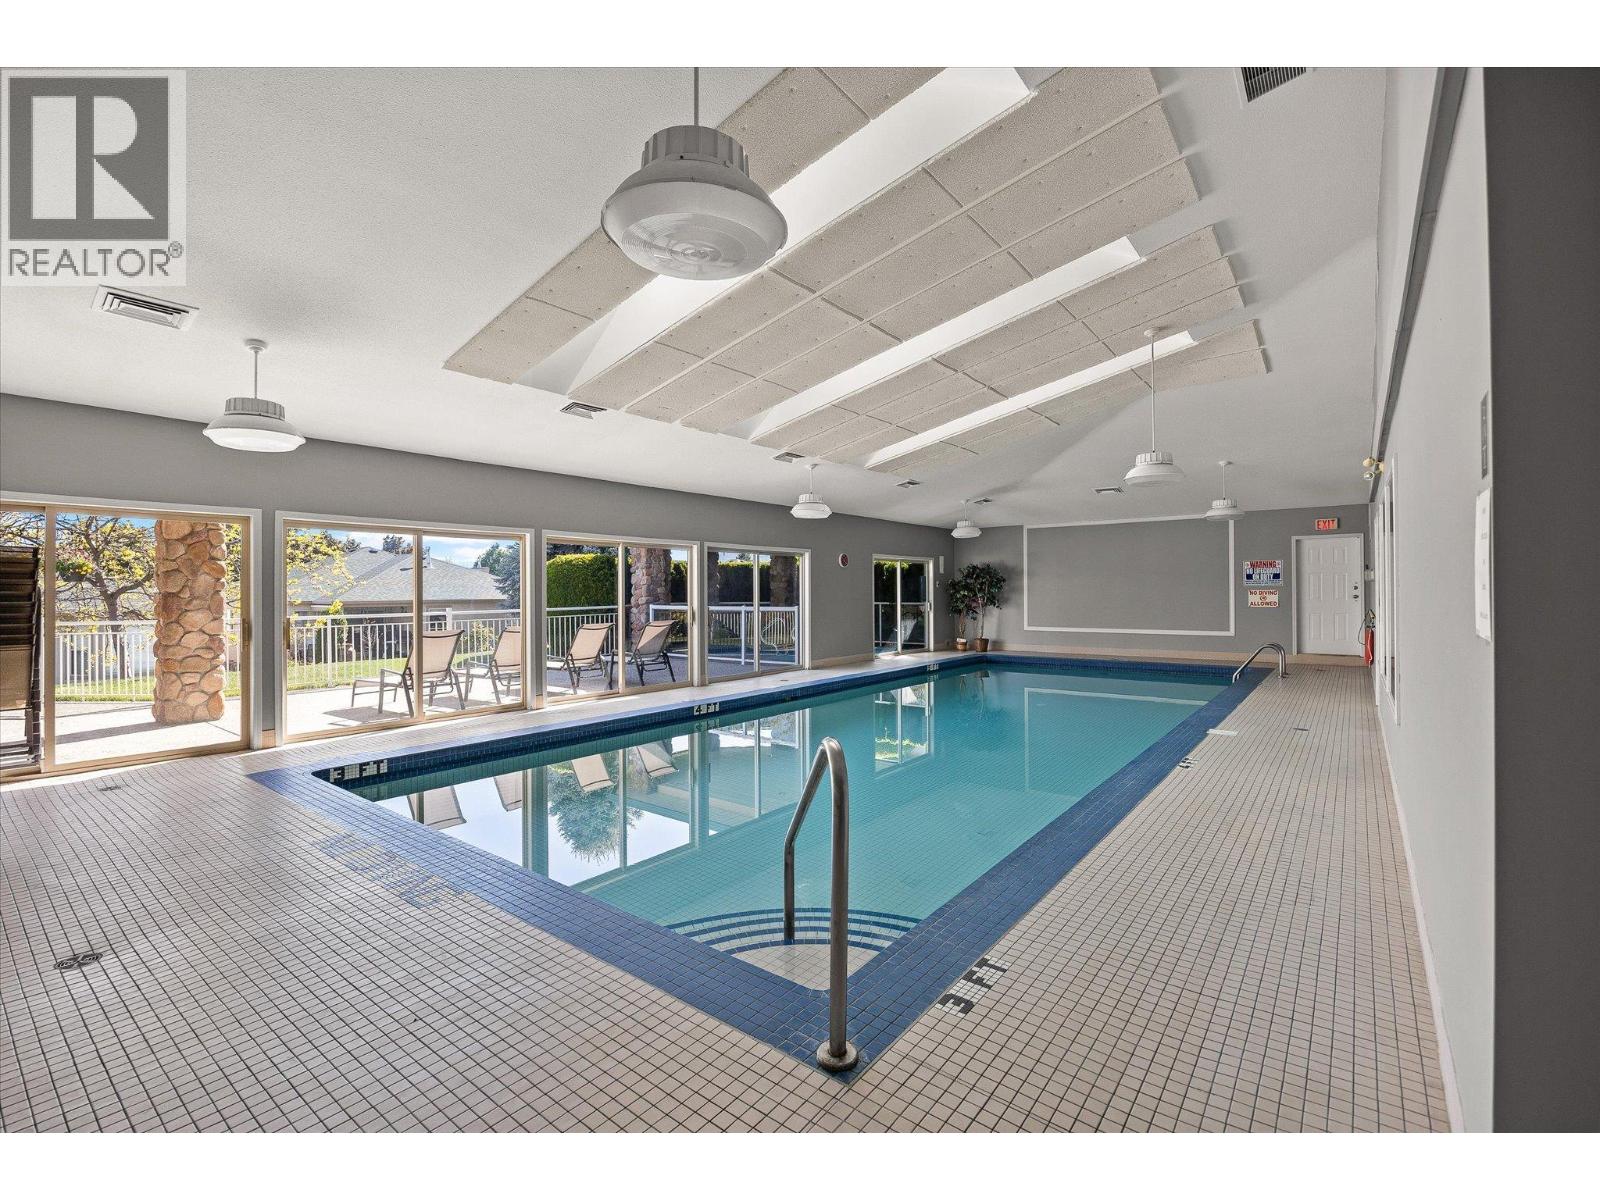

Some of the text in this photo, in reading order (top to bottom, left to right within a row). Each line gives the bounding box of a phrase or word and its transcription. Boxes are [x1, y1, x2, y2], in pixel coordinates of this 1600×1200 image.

[1316, 519, 1336, 530] EXIT
[937, 956, 1008, 1015] 3 FT
